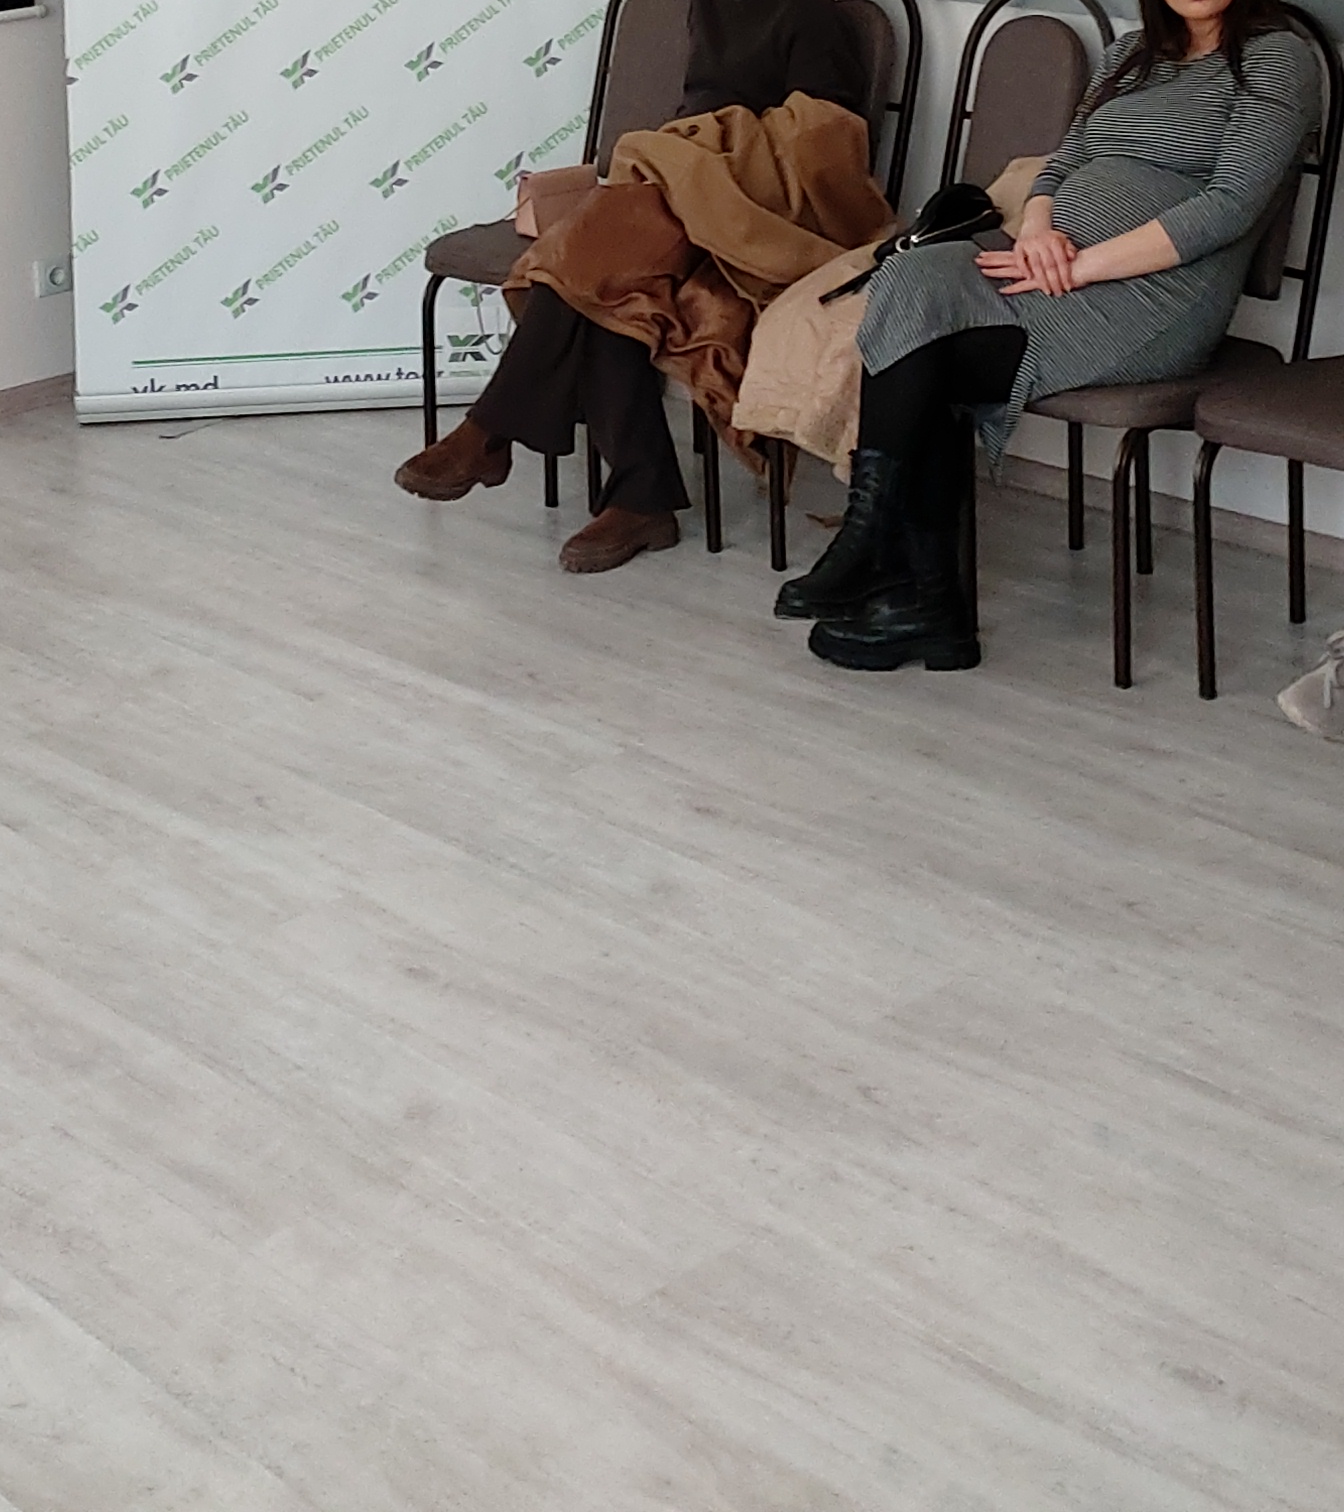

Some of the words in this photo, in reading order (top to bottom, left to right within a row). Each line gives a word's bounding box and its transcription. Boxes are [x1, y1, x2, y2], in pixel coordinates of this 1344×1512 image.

[74, 20, 137, 71] PRIETENUL
[194, 15, 256, 67] PRIETENUL
[314, 11, 376, 63] PRIETENUL
[438, 5, 500, 54] PRIETENUL
[164, 130, 227, 182] PRIETENUL
[285, 126, 346, 177] PRIETENUL
[403, 121, 466, 172] PRIETENUL
[135, 245, 197, 296] PRIETENUL
[256, 239, 316, 290] PRIETENUL
